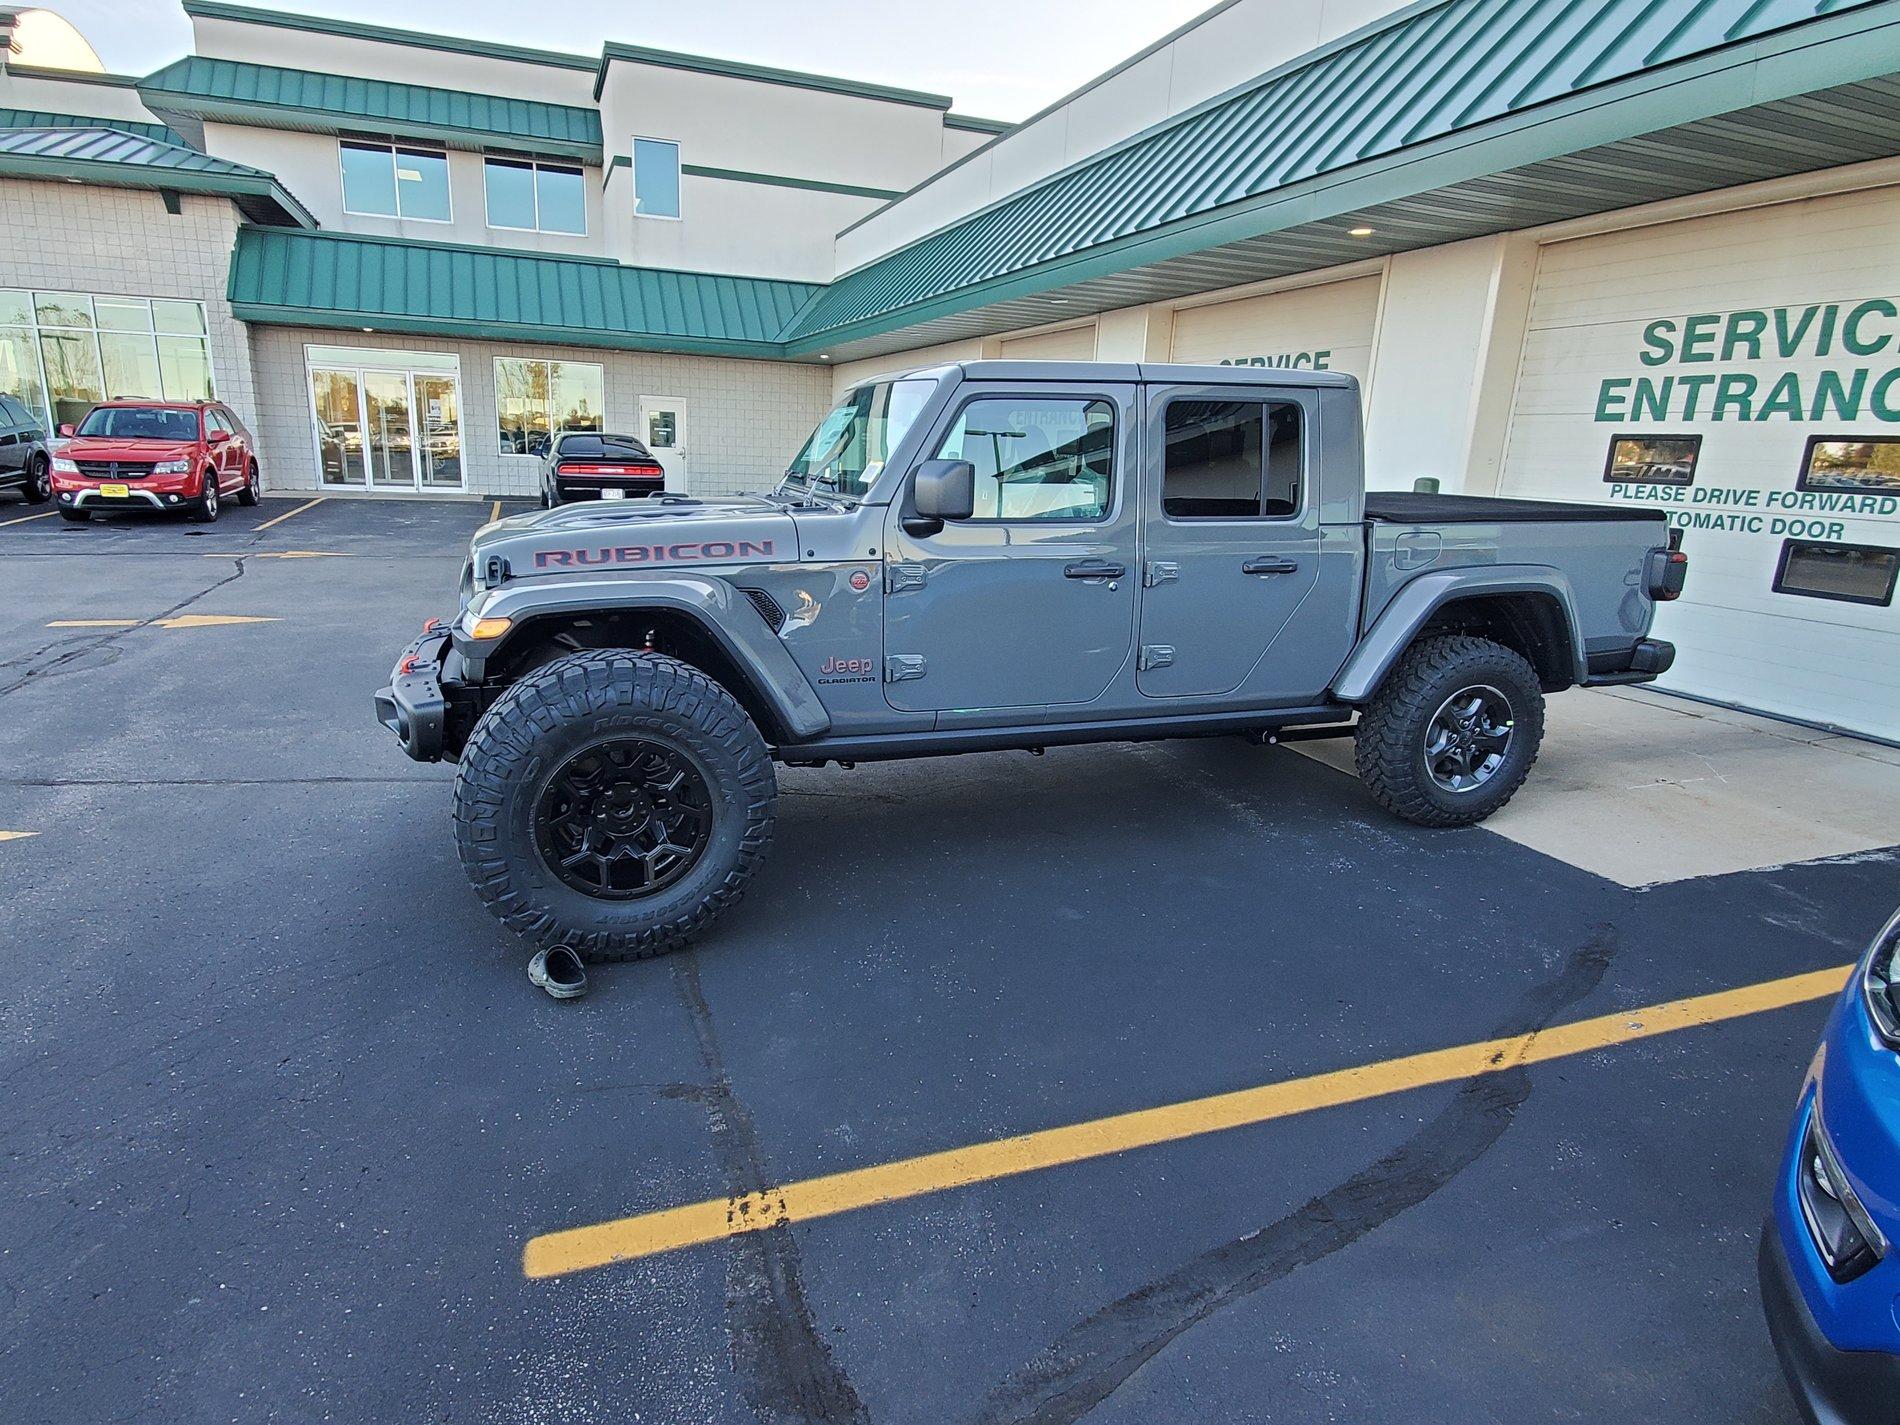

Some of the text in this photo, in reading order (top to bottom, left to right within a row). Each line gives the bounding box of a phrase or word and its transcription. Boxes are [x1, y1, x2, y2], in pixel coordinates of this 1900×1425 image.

[1639, 299, 1900, 366] SERVIC
[1594, 367, 1900, 422] ENTRANC
[1610, 484, 1897, 515] PLEASE DRIVE FORWARD
[1666, 510, 1845, 540] TOMATIC DOOR
[534, 540, 774, 569] RUBICON
[818, 676, 876, 685] GLADIATOR
[820, 656, 874, 676] Jeep
